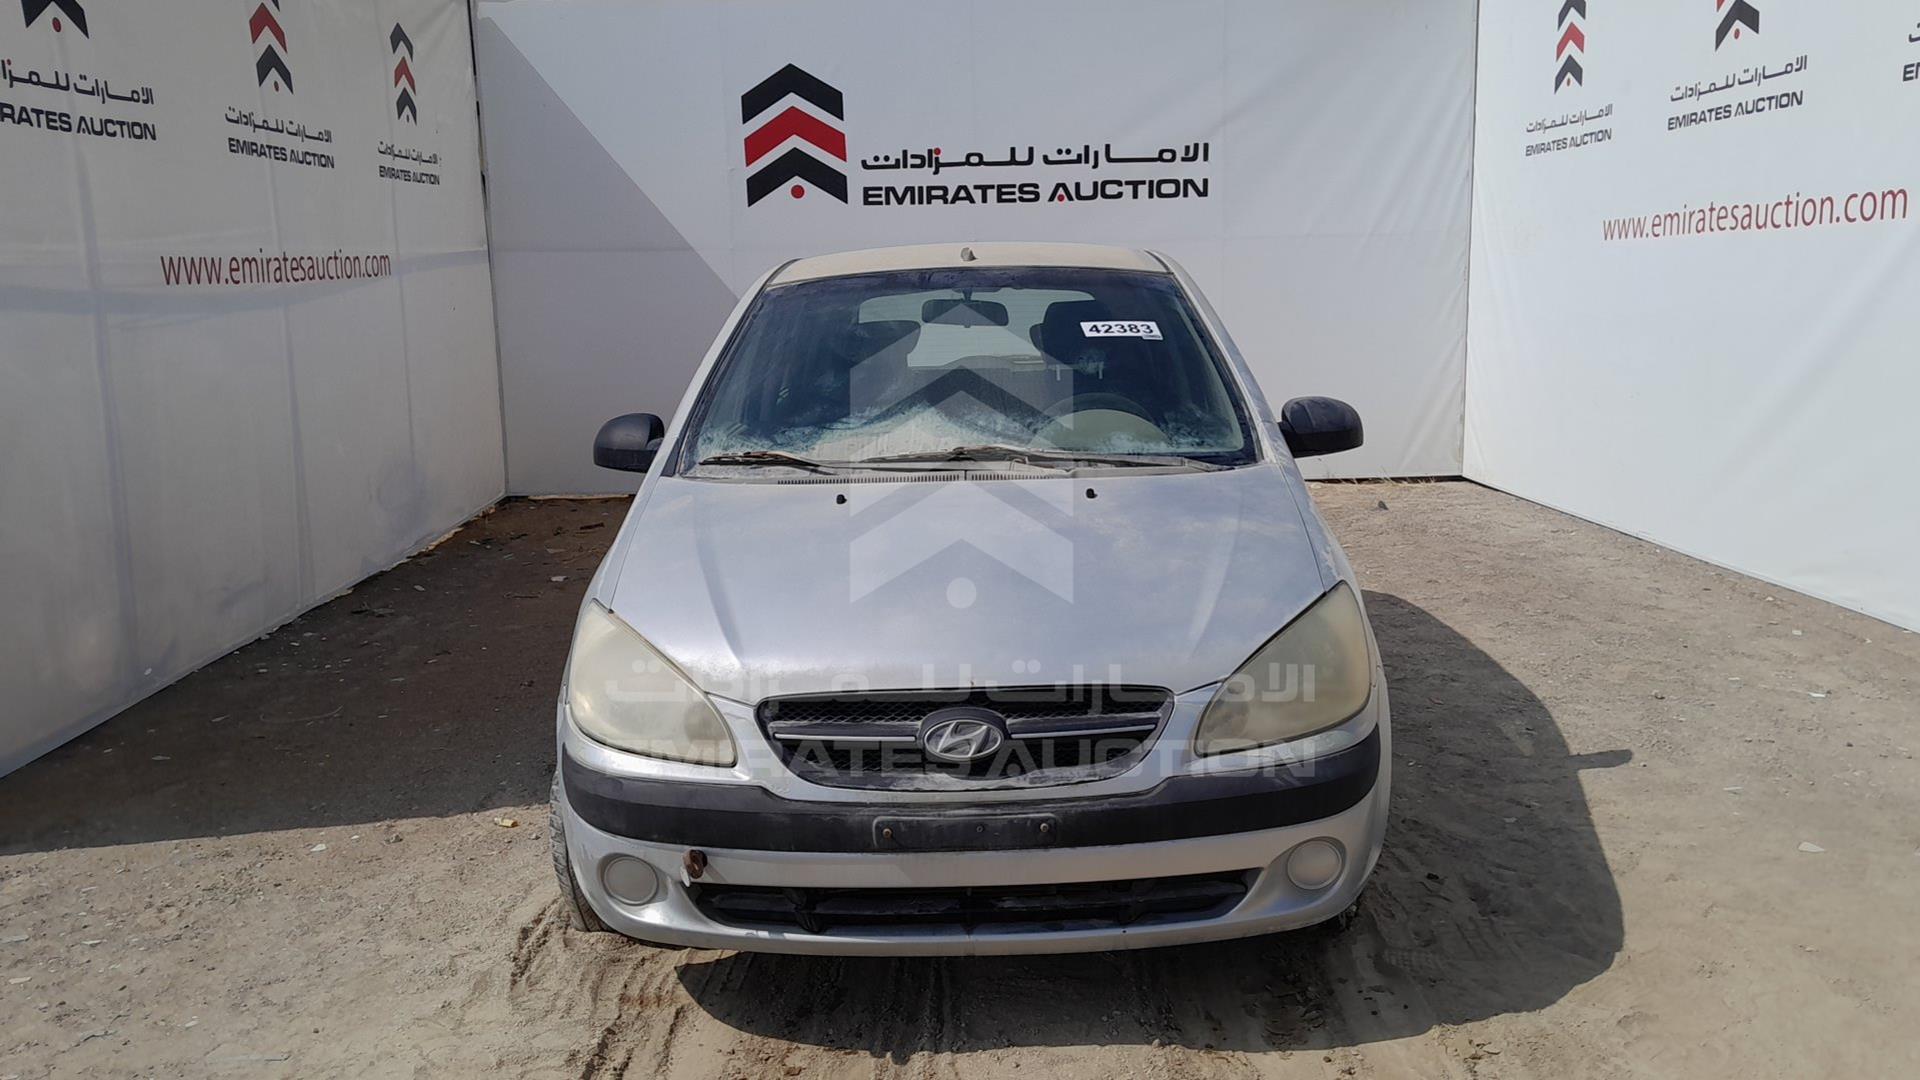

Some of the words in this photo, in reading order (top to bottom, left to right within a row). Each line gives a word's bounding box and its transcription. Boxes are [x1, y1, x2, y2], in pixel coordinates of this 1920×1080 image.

[1667, 104, 1732, 131] EMIRATES
[1734, 90, 1804, 117] AUCTION
[76, 116, 157, 141] AUCTION
[1525, 137, 1568, 157] EMIRATES
[1568, 127, 1612, 148] AUCTION
[228, 137, 288, 162] EMIRATES
[290, 149, 335, 169] AUCTION
[861, 146, 1034, 175] للمزادات
[1043, 142, 1209, 169] الامارات
[379, 165, 411, 182] EMIRATES
[412, 171, 440, 185] AUCTION
[863, 183, 1040, 206] EMIRATES
[1048, 178, 1208, 202] AUCTION
[1603, 187, 1908, 241] www.emiratesauction.com
[160, 248, 391, 286] www.emiratesauction.com
[1088, 323, 1154, 334] 42383
